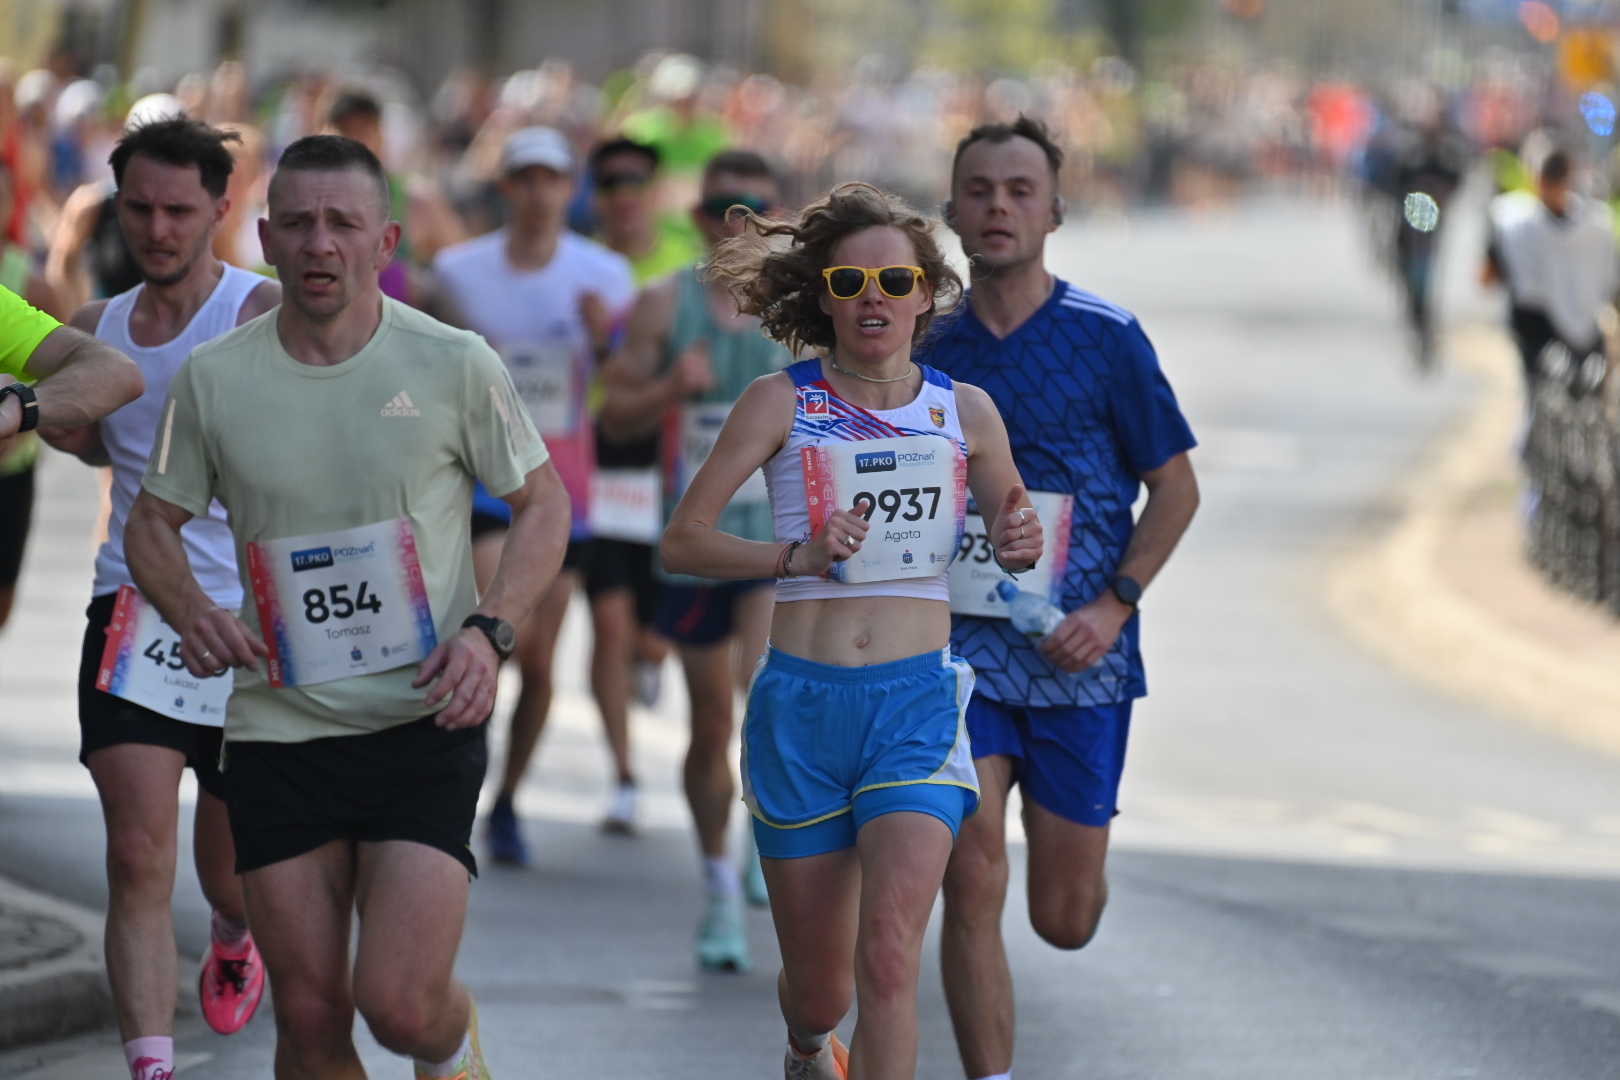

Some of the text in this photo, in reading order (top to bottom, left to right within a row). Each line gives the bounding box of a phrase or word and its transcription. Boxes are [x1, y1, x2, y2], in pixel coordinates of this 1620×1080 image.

[380, 407, 420, 417] adidas
[859, 457, 893, 467] 17.PKO
[853, 486, 941, 523] 9937
[884, 529, 921, 543] Agata
[294, 551, 329, 566] 17.PKO
[302, 581, 382, 624] 854
[325, 625, 371, 640] Tomasz
